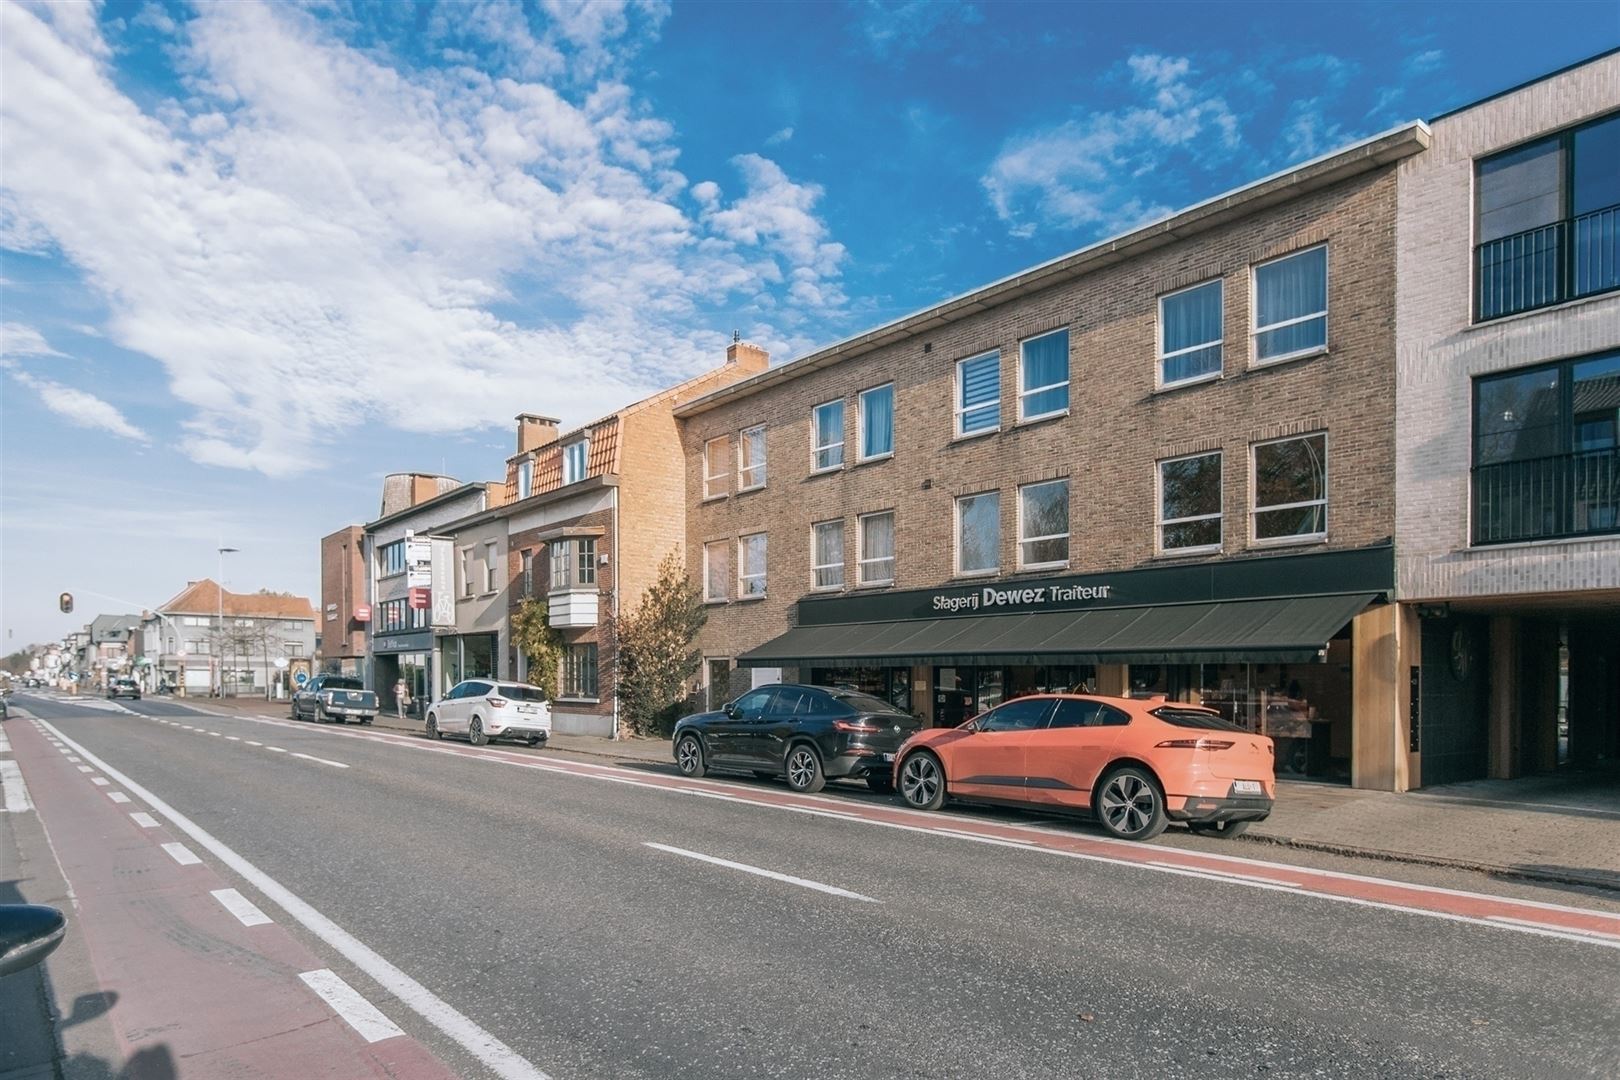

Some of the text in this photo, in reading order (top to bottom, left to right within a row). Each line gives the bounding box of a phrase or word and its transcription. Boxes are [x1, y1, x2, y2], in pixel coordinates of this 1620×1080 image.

[932, 585, 1111, 612] Slagerij Dewez Traiteur
